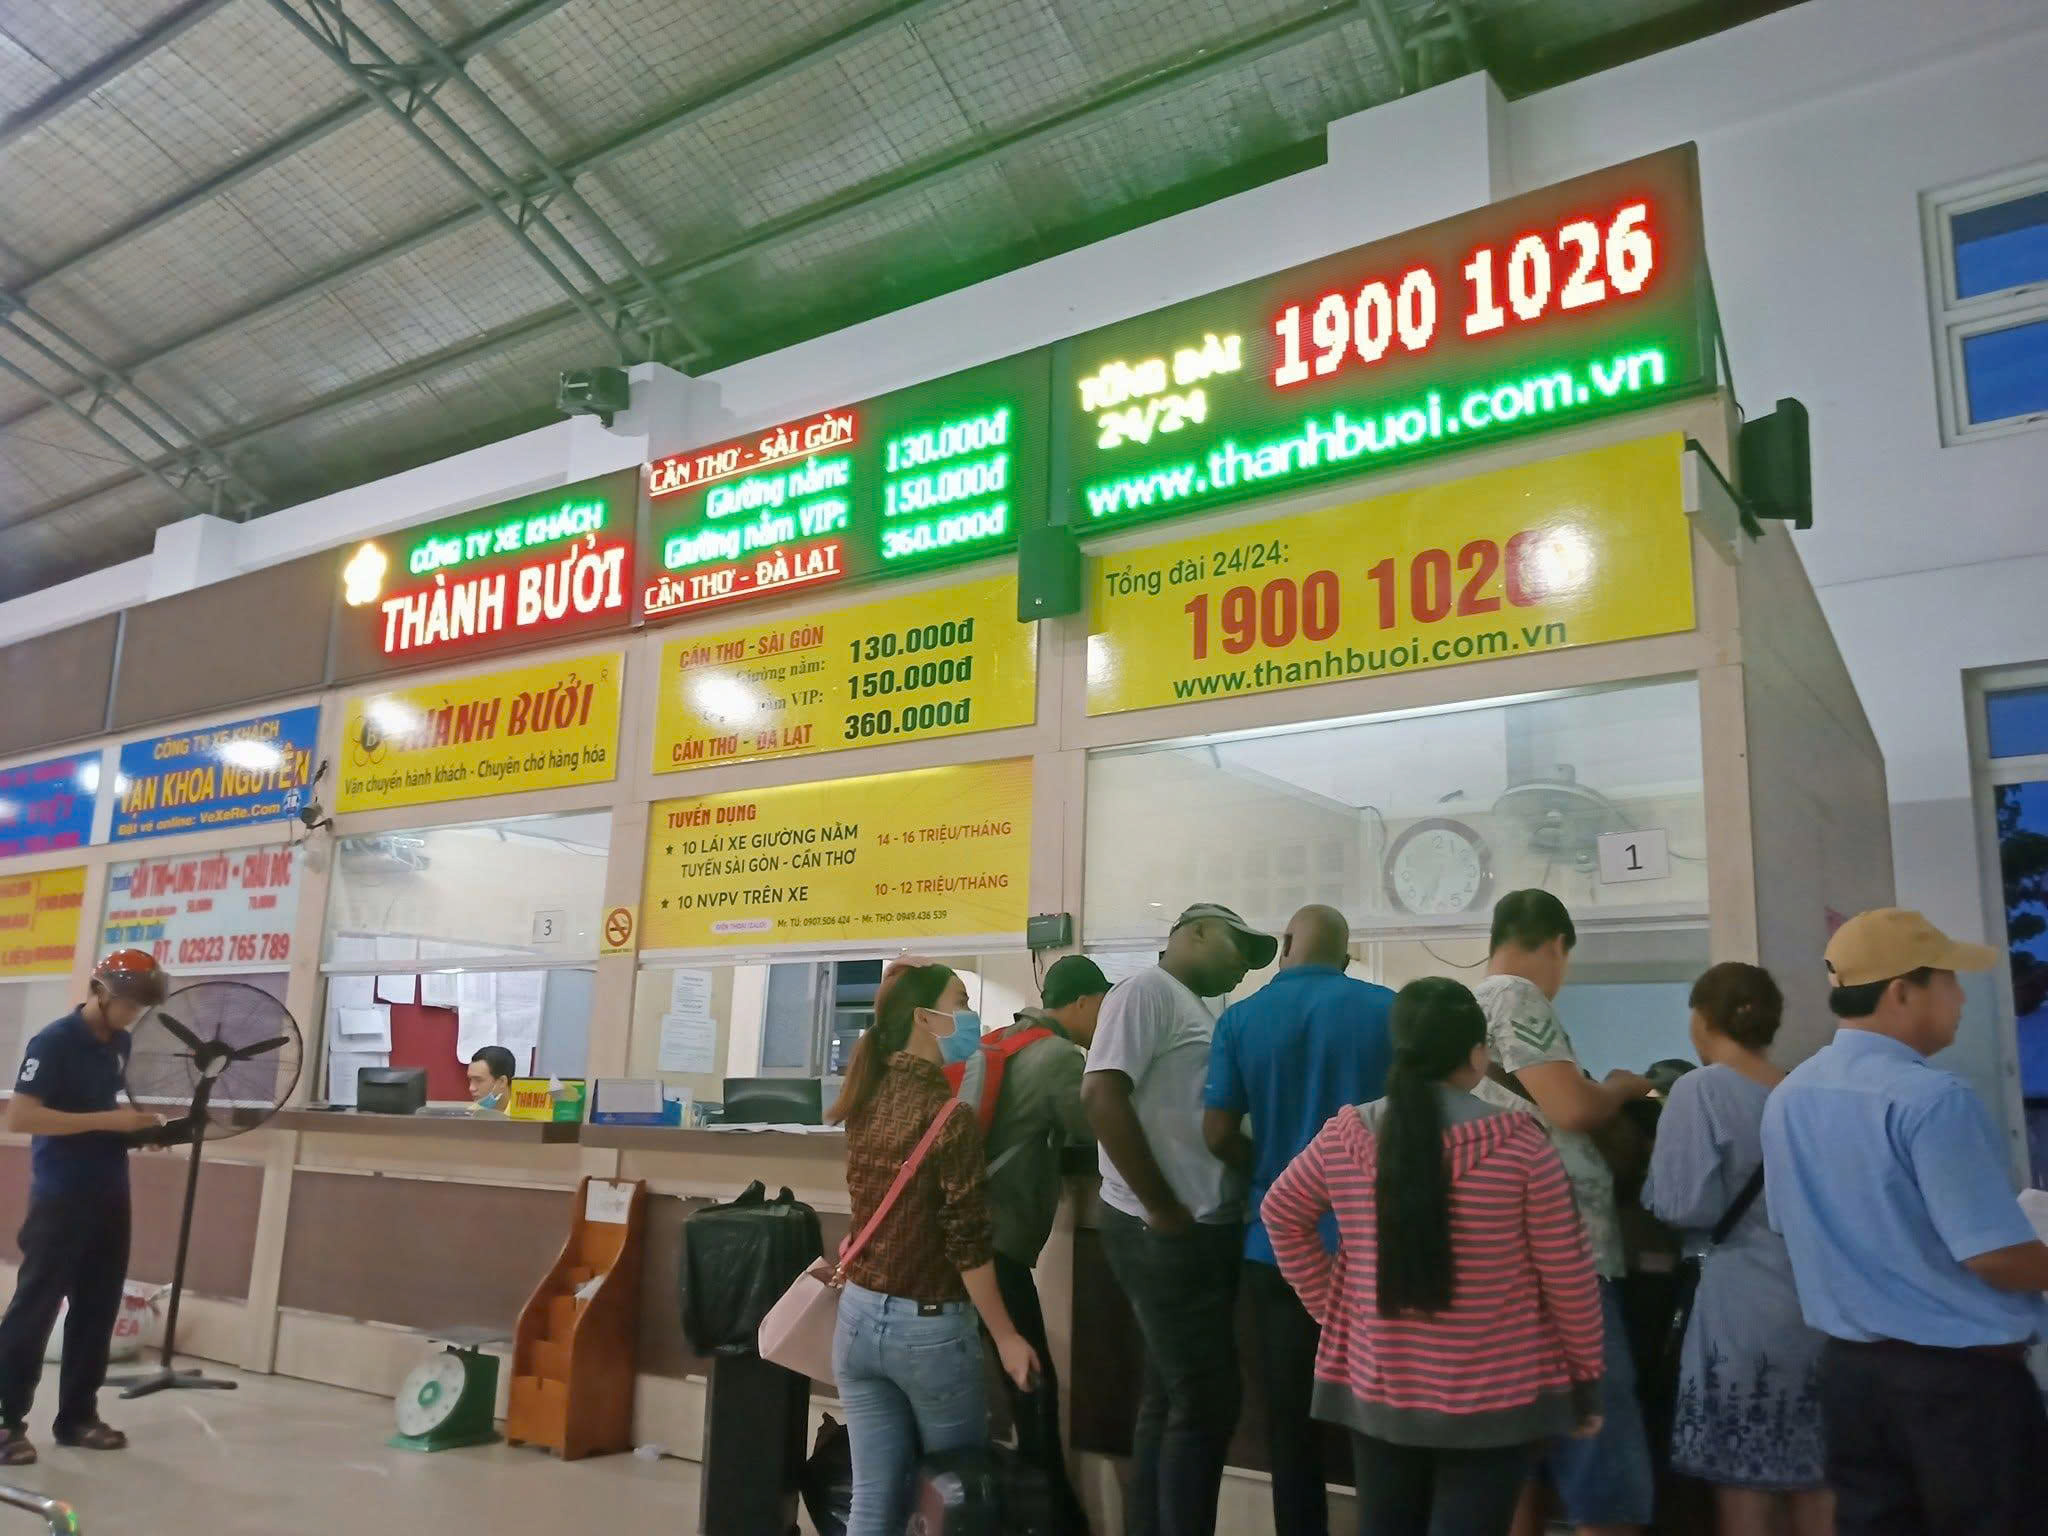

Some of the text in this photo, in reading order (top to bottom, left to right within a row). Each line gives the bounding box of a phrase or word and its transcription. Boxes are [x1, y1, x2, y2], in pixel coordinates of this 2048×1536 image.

[1274, 203, 1654, 388] 1900 1026
[759, 428, 800, 462] SÀI
[804, 413, 853, 449] GÒN
[886, 409, 1010, 473] 130.000đ
[1085, 346, 1667, 518] www.thanhbuoi.com.vn
[884, 457, 1008, 517] 150.000đ
[466, 532, 492, 560] TY
[494, 523, 523, 553] XE
[881, 504, 1008, 559] 360.000đ
[755, 550, 789, 585] ĐÀ
[1105, 540, 1290, 598] Tổng đài 24/24:
[382, 533, 625, 653] THÀNH BƯỞI
[1184, 569, 1340, 662] 1900
[850, 617, 974, 663] 130.000đ
[1173, 618, 1567, 700] www.thanhbuoi.com.vn
[791, 688, 824, 706] VIP:
[848, 655, 973, 700] 150.000đ
[400, 672, 595, 751] HÀNH BƯỞI
[844, 697, 971, 740] 360.000đ
[477, 756, 520, 781] Chuyên
[548, 749, 579, 771] hàng
[583, 743, 606, 764] hóa
[161, 767, 215, 807] KHOA
[682, 841, 696, 855] 10
[728, 836, 747, 851] XE
[877, 833, 890, 846] 14
[902, 831, 916, 844] 16
[1625, 843, 1644, 871] 1
[749, 855, 779, 873] GÒN
[678, 885, 809, 910] 10 NVPV TRÊN XE
[875, 883, 888, 896] 10
[900, 881, 912, 894] 12
[228, 933, 258, 961] 765
[260, 932, 292, 960] 789
[543, 919, 552, 936] 3
[21, 1058, 40, 1082] 3
